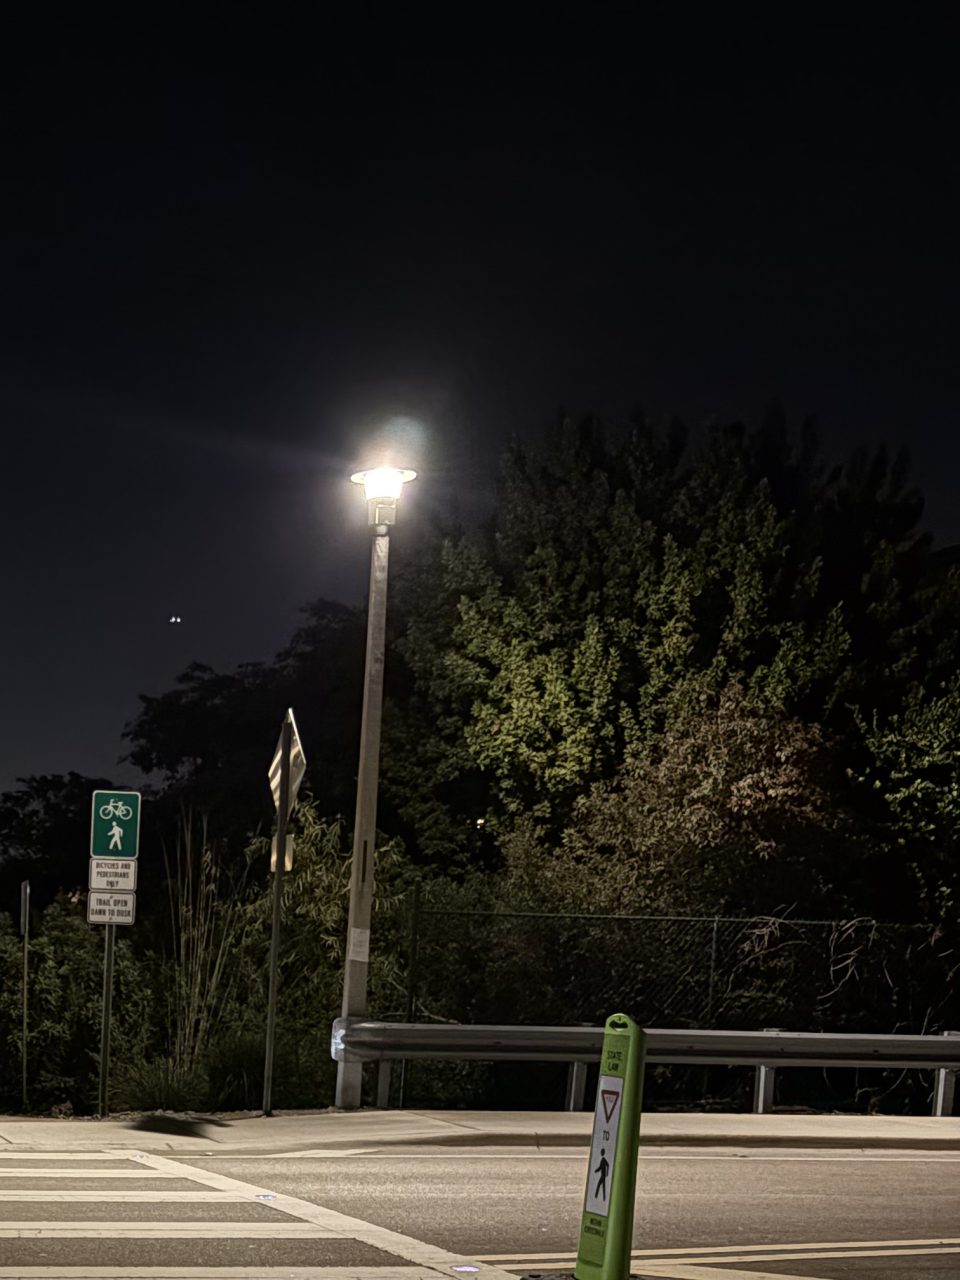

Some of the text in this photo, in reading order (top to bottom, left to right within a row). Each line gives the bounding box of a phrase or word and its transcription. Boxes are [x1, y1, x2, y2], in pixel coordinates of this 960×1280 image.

[96, 871, 129, 879] PEDESTRIANS
[106, 880, 119, 888] ONLY
[96, 898, 128, 907] TRAIL OPEN
[91, 908, 106, 916] DAWN
[116, 909, 131, 917] DUSK
[607, 1050, 622, 1061] STATE
[607, 1062, 619, 1072] LAW
[602, 1130, 610, 1142] TO
